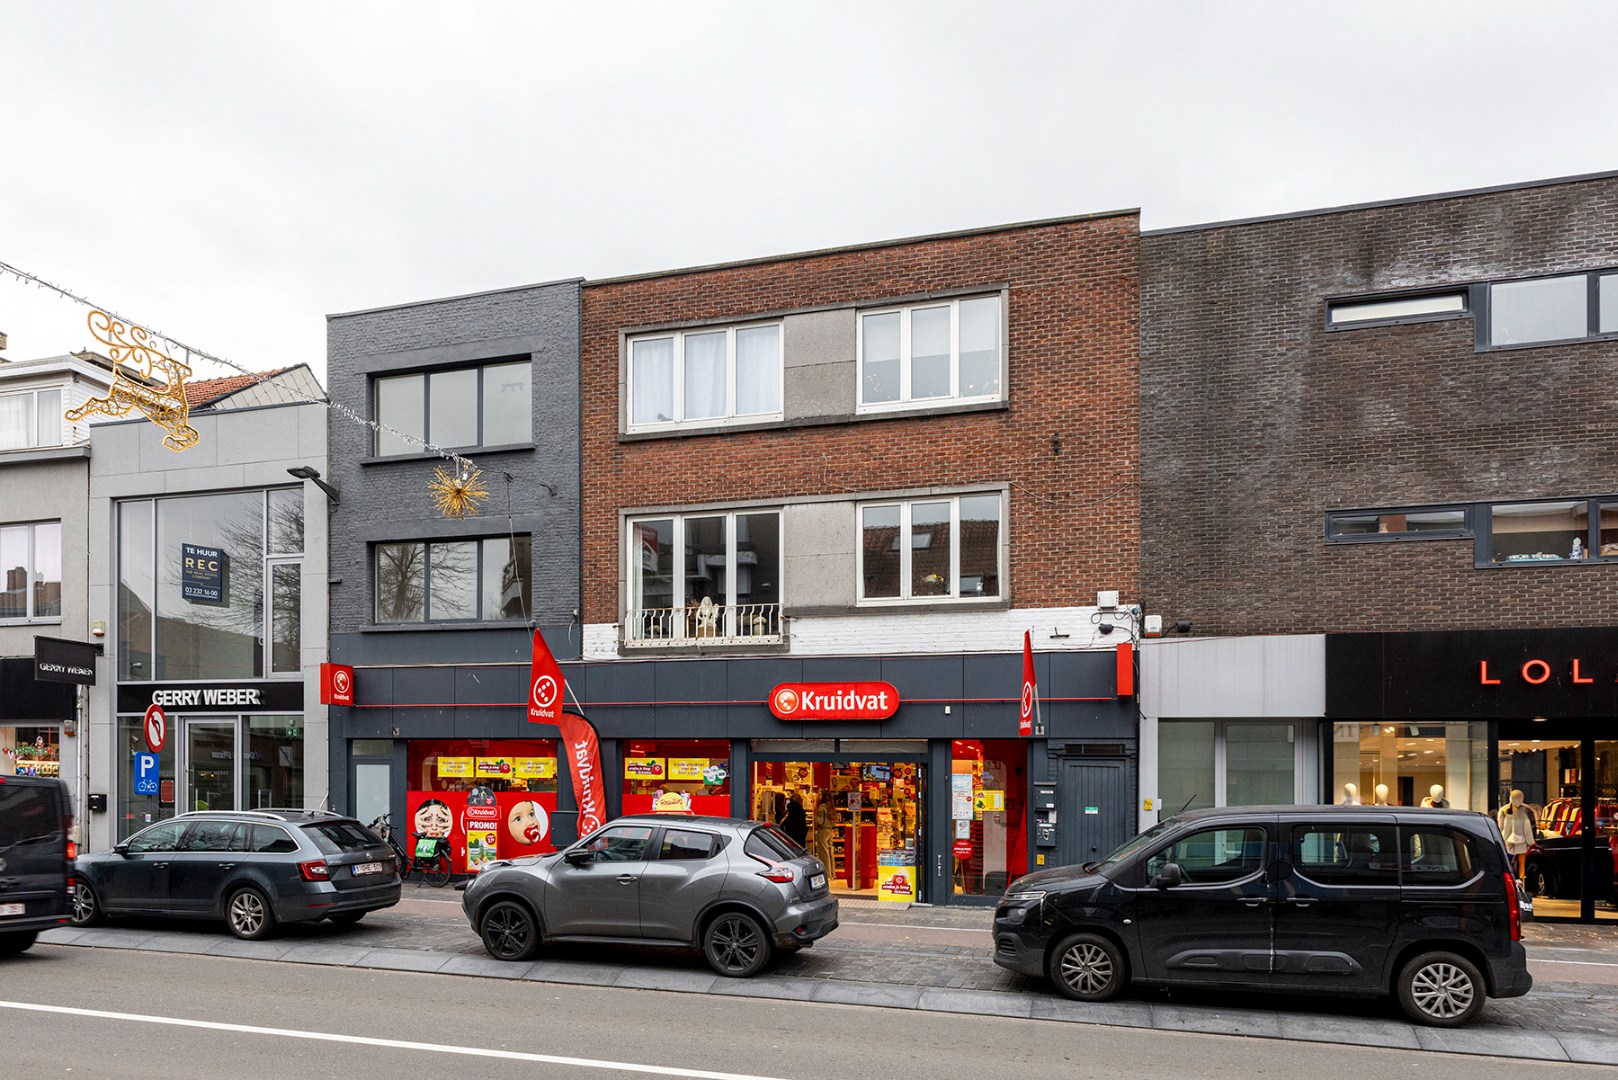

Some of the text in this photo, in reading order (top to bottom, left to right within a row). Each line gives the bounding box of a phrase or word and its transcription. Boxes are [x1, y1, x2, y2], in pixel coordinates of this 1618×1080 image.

[185, 547, 218, 558] TE HUUR
[185, 557, 219, 572] REC
[185, 586, 193, 594] 03
[193, 587, 203, 595] 232
[40, 662, 65, 673] GERRY
[1481, 659, 1618, 685] LOL
[152, 688, 262, 706] GERRY WEBER
[802, 689, 889, 711] Kruidvat
[530, 707, 555, 719] Kruidvat
[140, 755, 155, 778] P
[575, 740, 596, 815] Kruidvat
[474, 808, 495, 816] Kruidvat
[469, 820, 498, 830] PROMO!
